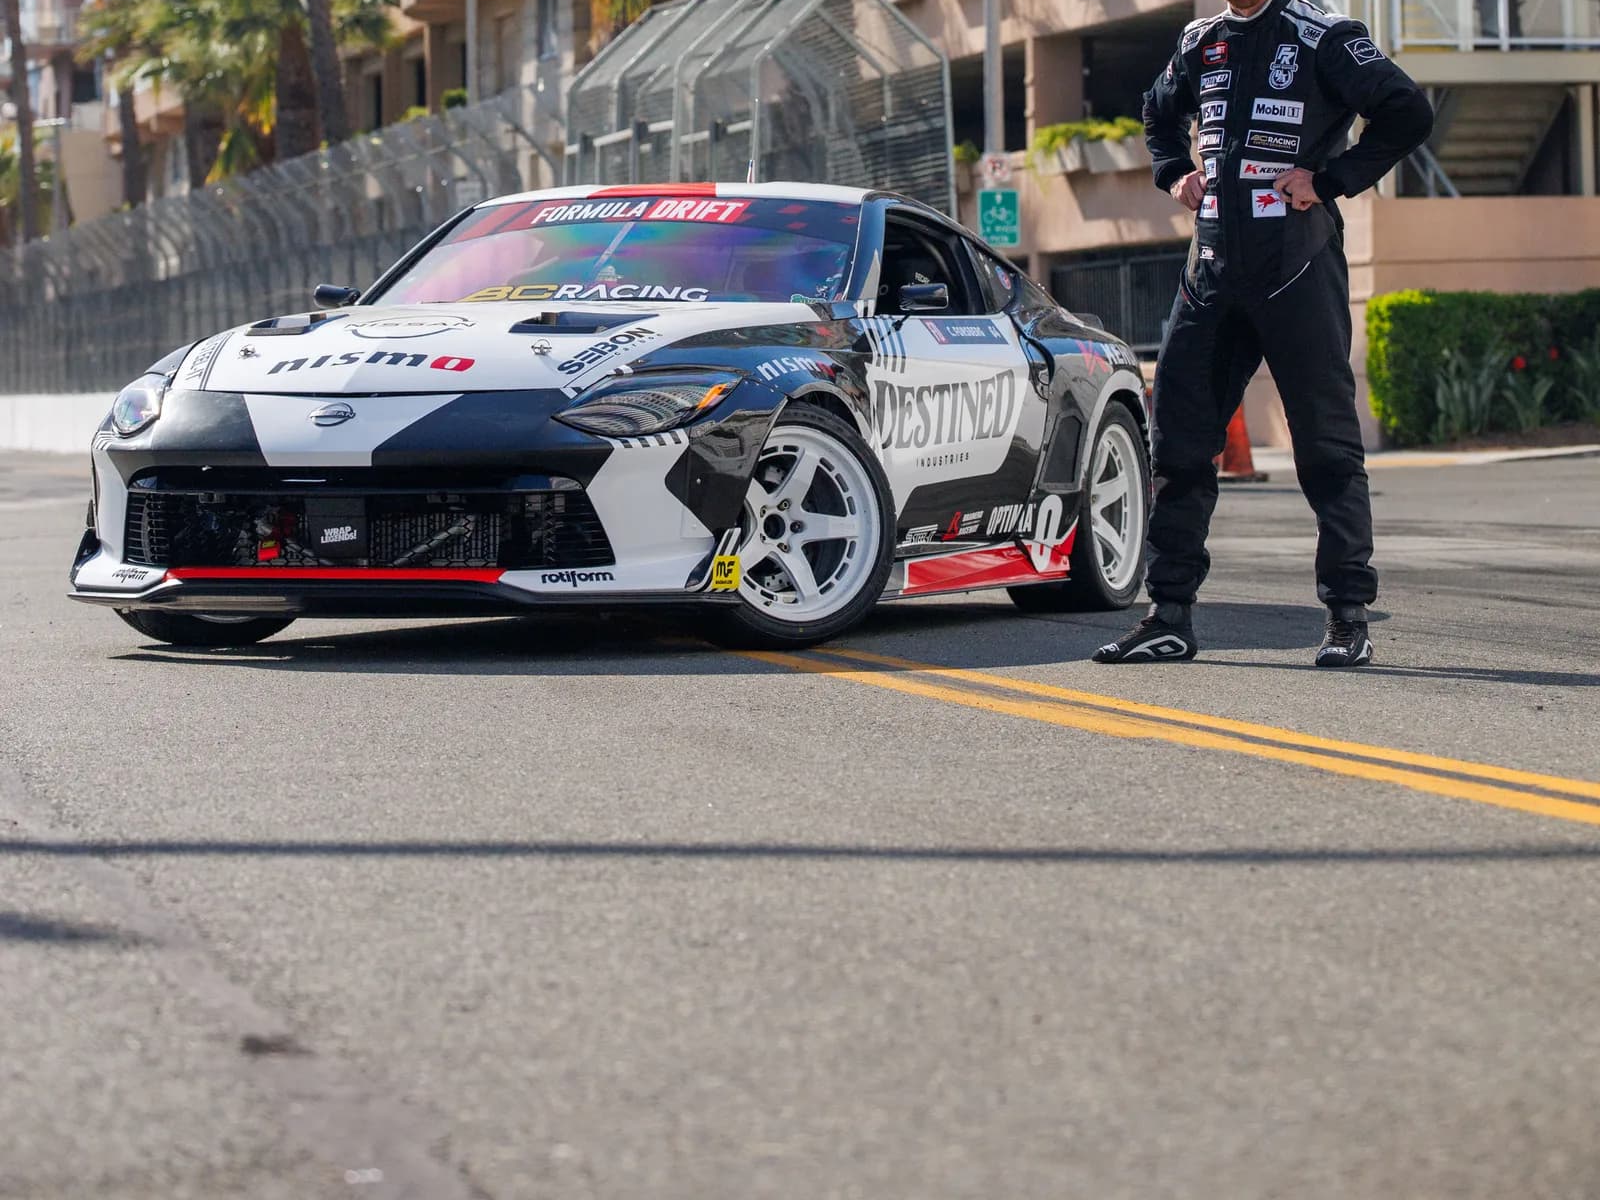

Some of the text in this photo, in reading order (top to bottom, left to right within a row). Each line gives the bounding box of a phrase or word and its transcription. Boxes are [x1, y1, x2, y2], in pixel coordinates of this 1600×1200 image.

[1303, 27, 1321, 40] OMP
[1203, 104, 1224, 118] SMO
[1255, 103, 1287, 117] Mobil
[1260, 166, 1290, 175] KEND
[531, 199, 744, 224] FORMULA DRIFT
[557, 327, 655, 375] SEIBON
[874, 369, 1016, 449] DESTINED
[916, 451, 969, 468] INDUSTRIES
[320, 529, 358, 544] LEGENDS!
[323, 526, 352, 538] WRAP
[541, 570, 615, 588] rotiform
